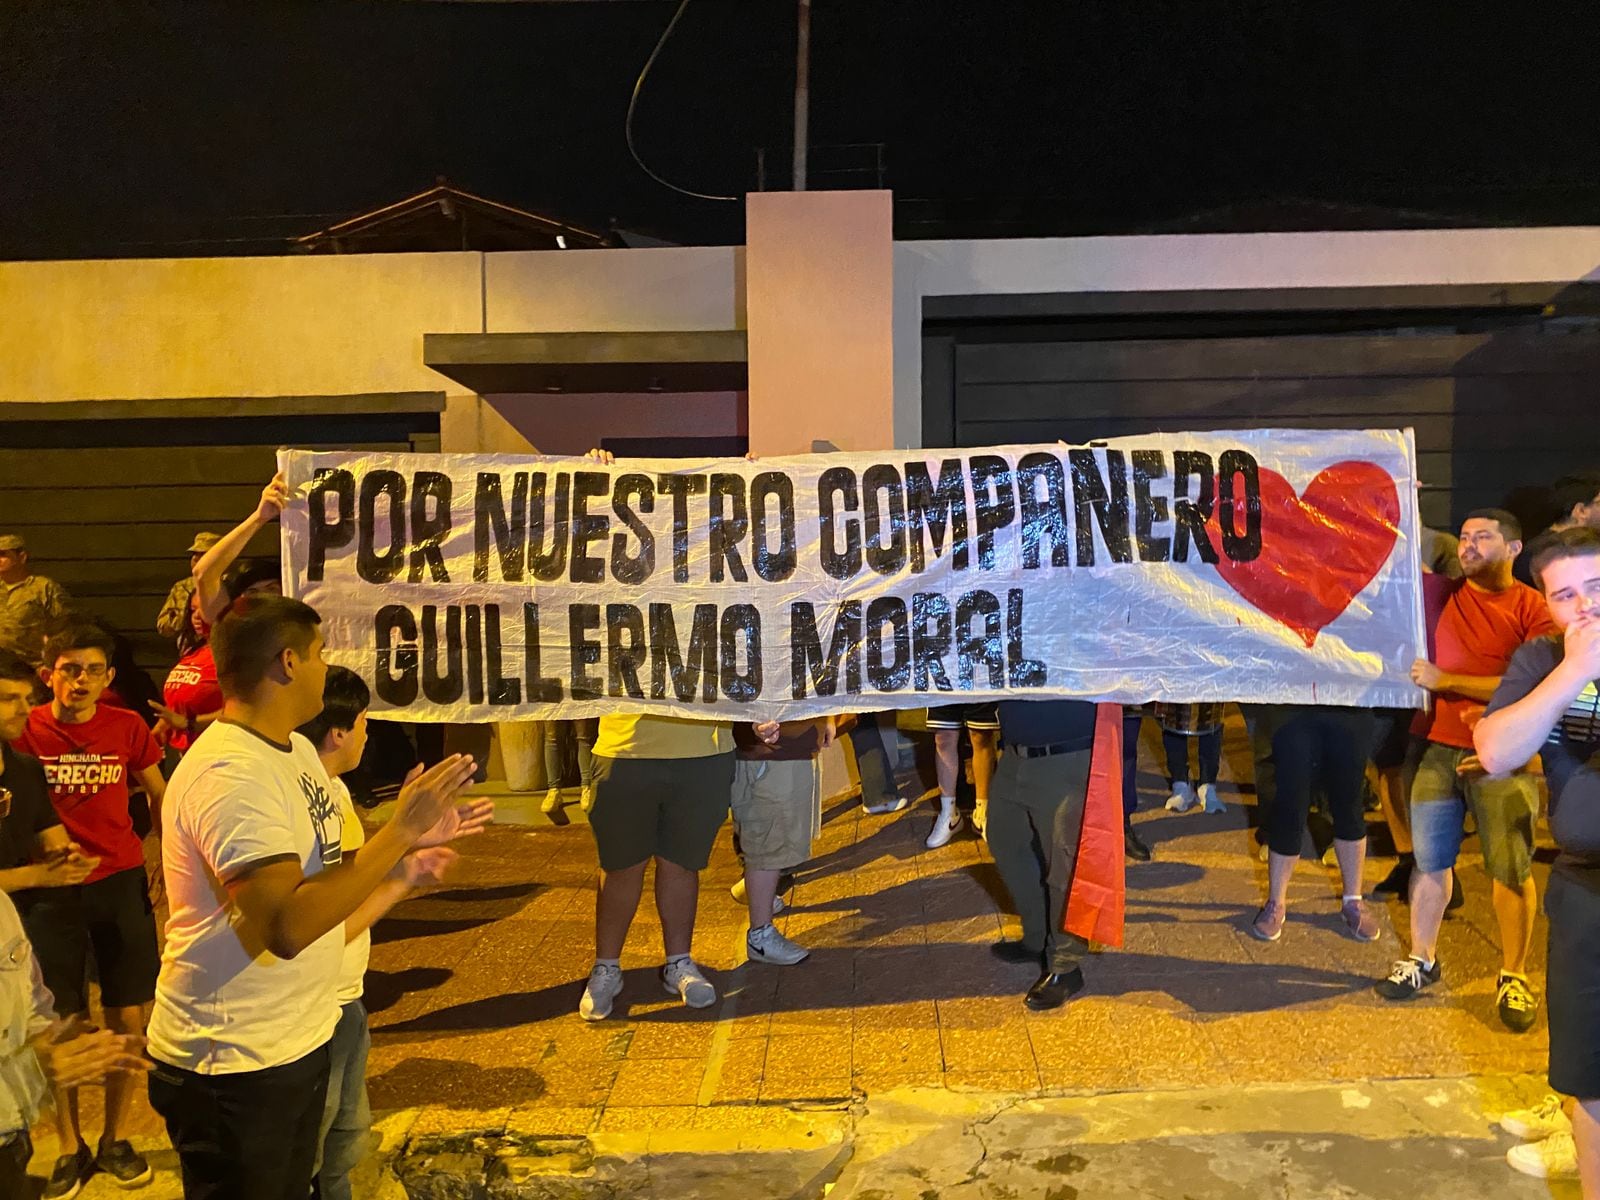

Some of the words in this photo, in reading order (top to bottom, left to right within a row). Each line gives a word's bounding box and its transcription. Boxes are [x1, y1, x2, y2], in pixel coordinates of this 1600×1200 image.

[307, 468, 453, 584] POR
[472, 472, 797, 585] NUESTRO
[374, 602, 762, 706] GUILLERMO
[790, 589, 1047, 700] MORAL
[44, 764, 123, 784] ERECHO
